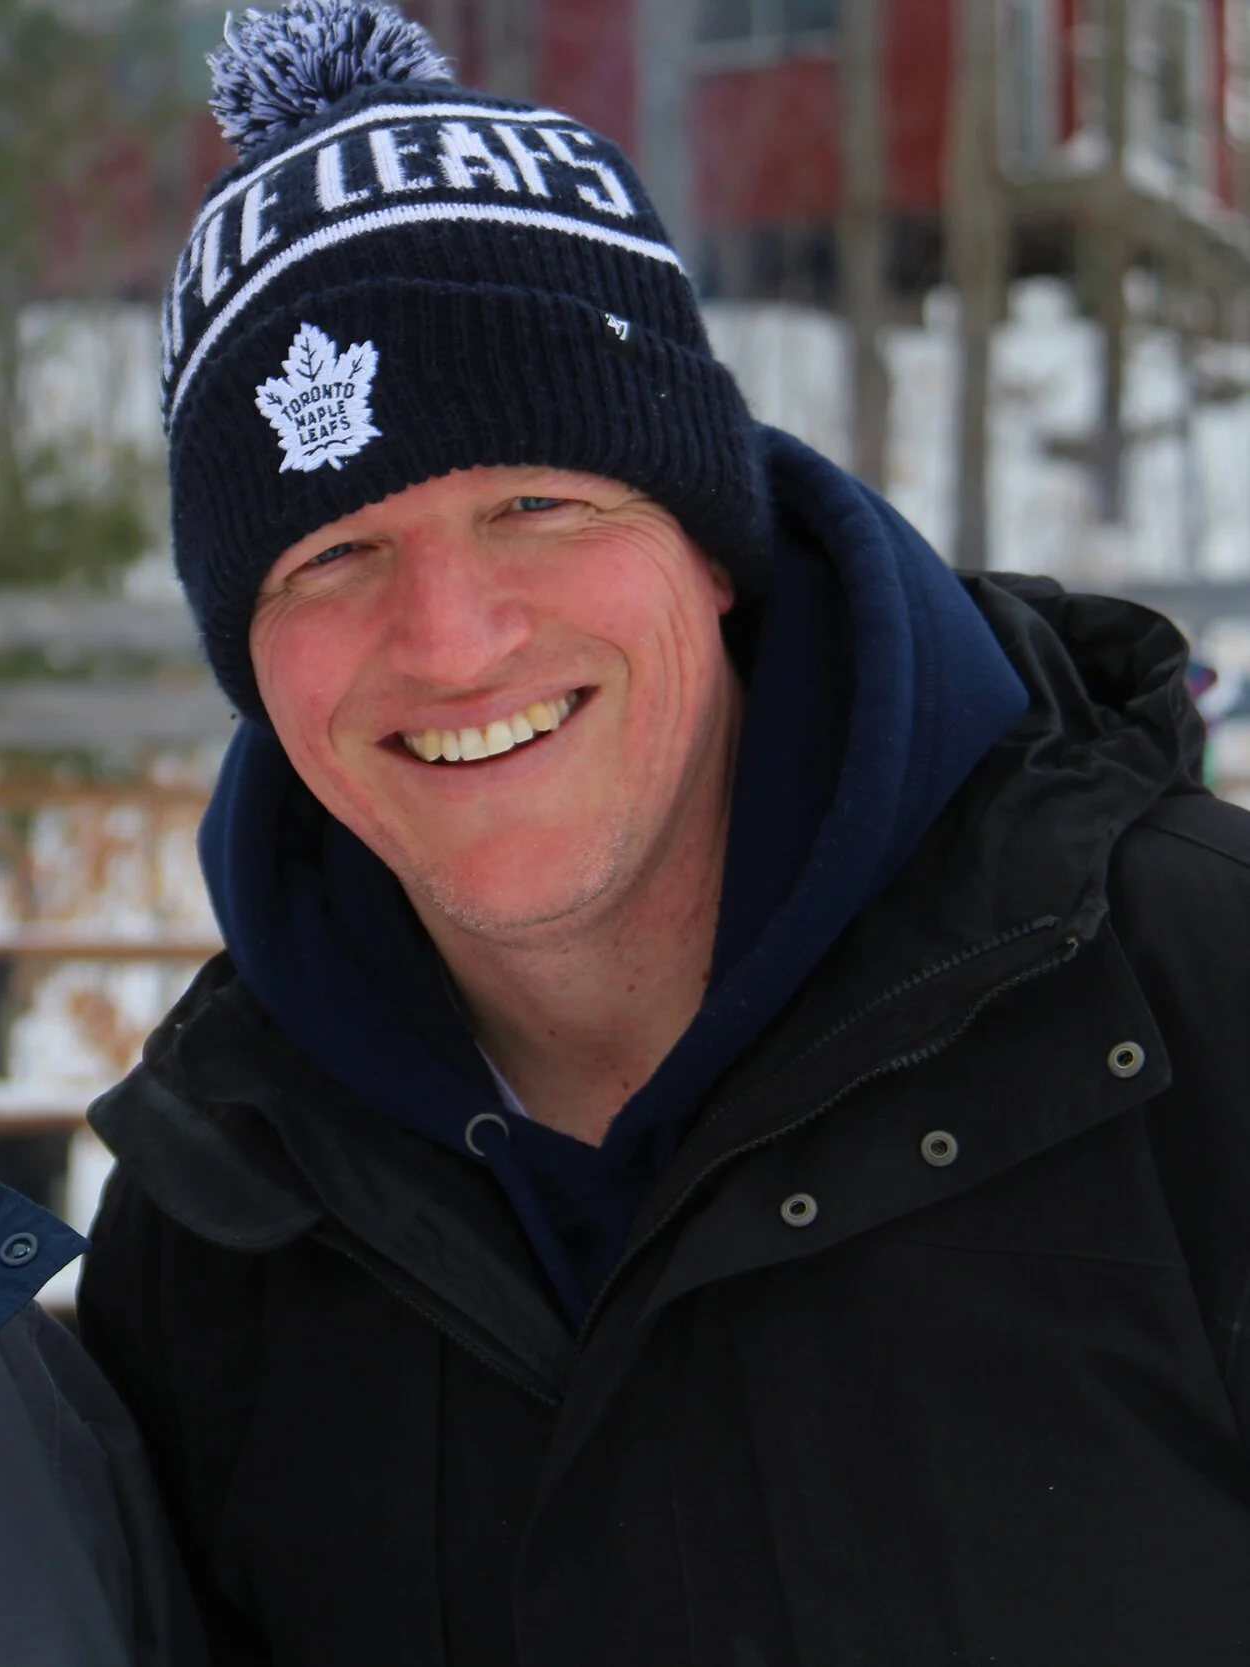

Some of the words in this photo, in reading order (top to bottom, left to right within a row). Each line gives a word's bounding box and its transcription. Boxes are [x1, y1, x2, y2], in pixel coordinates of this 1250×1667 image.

[315, 122, 635, 218] LEAFS
[280, 381, 356, 422] TORONTO
[293, 399, 347, 432] MAPLE
[299, 415, 351, 446] LEAFS
